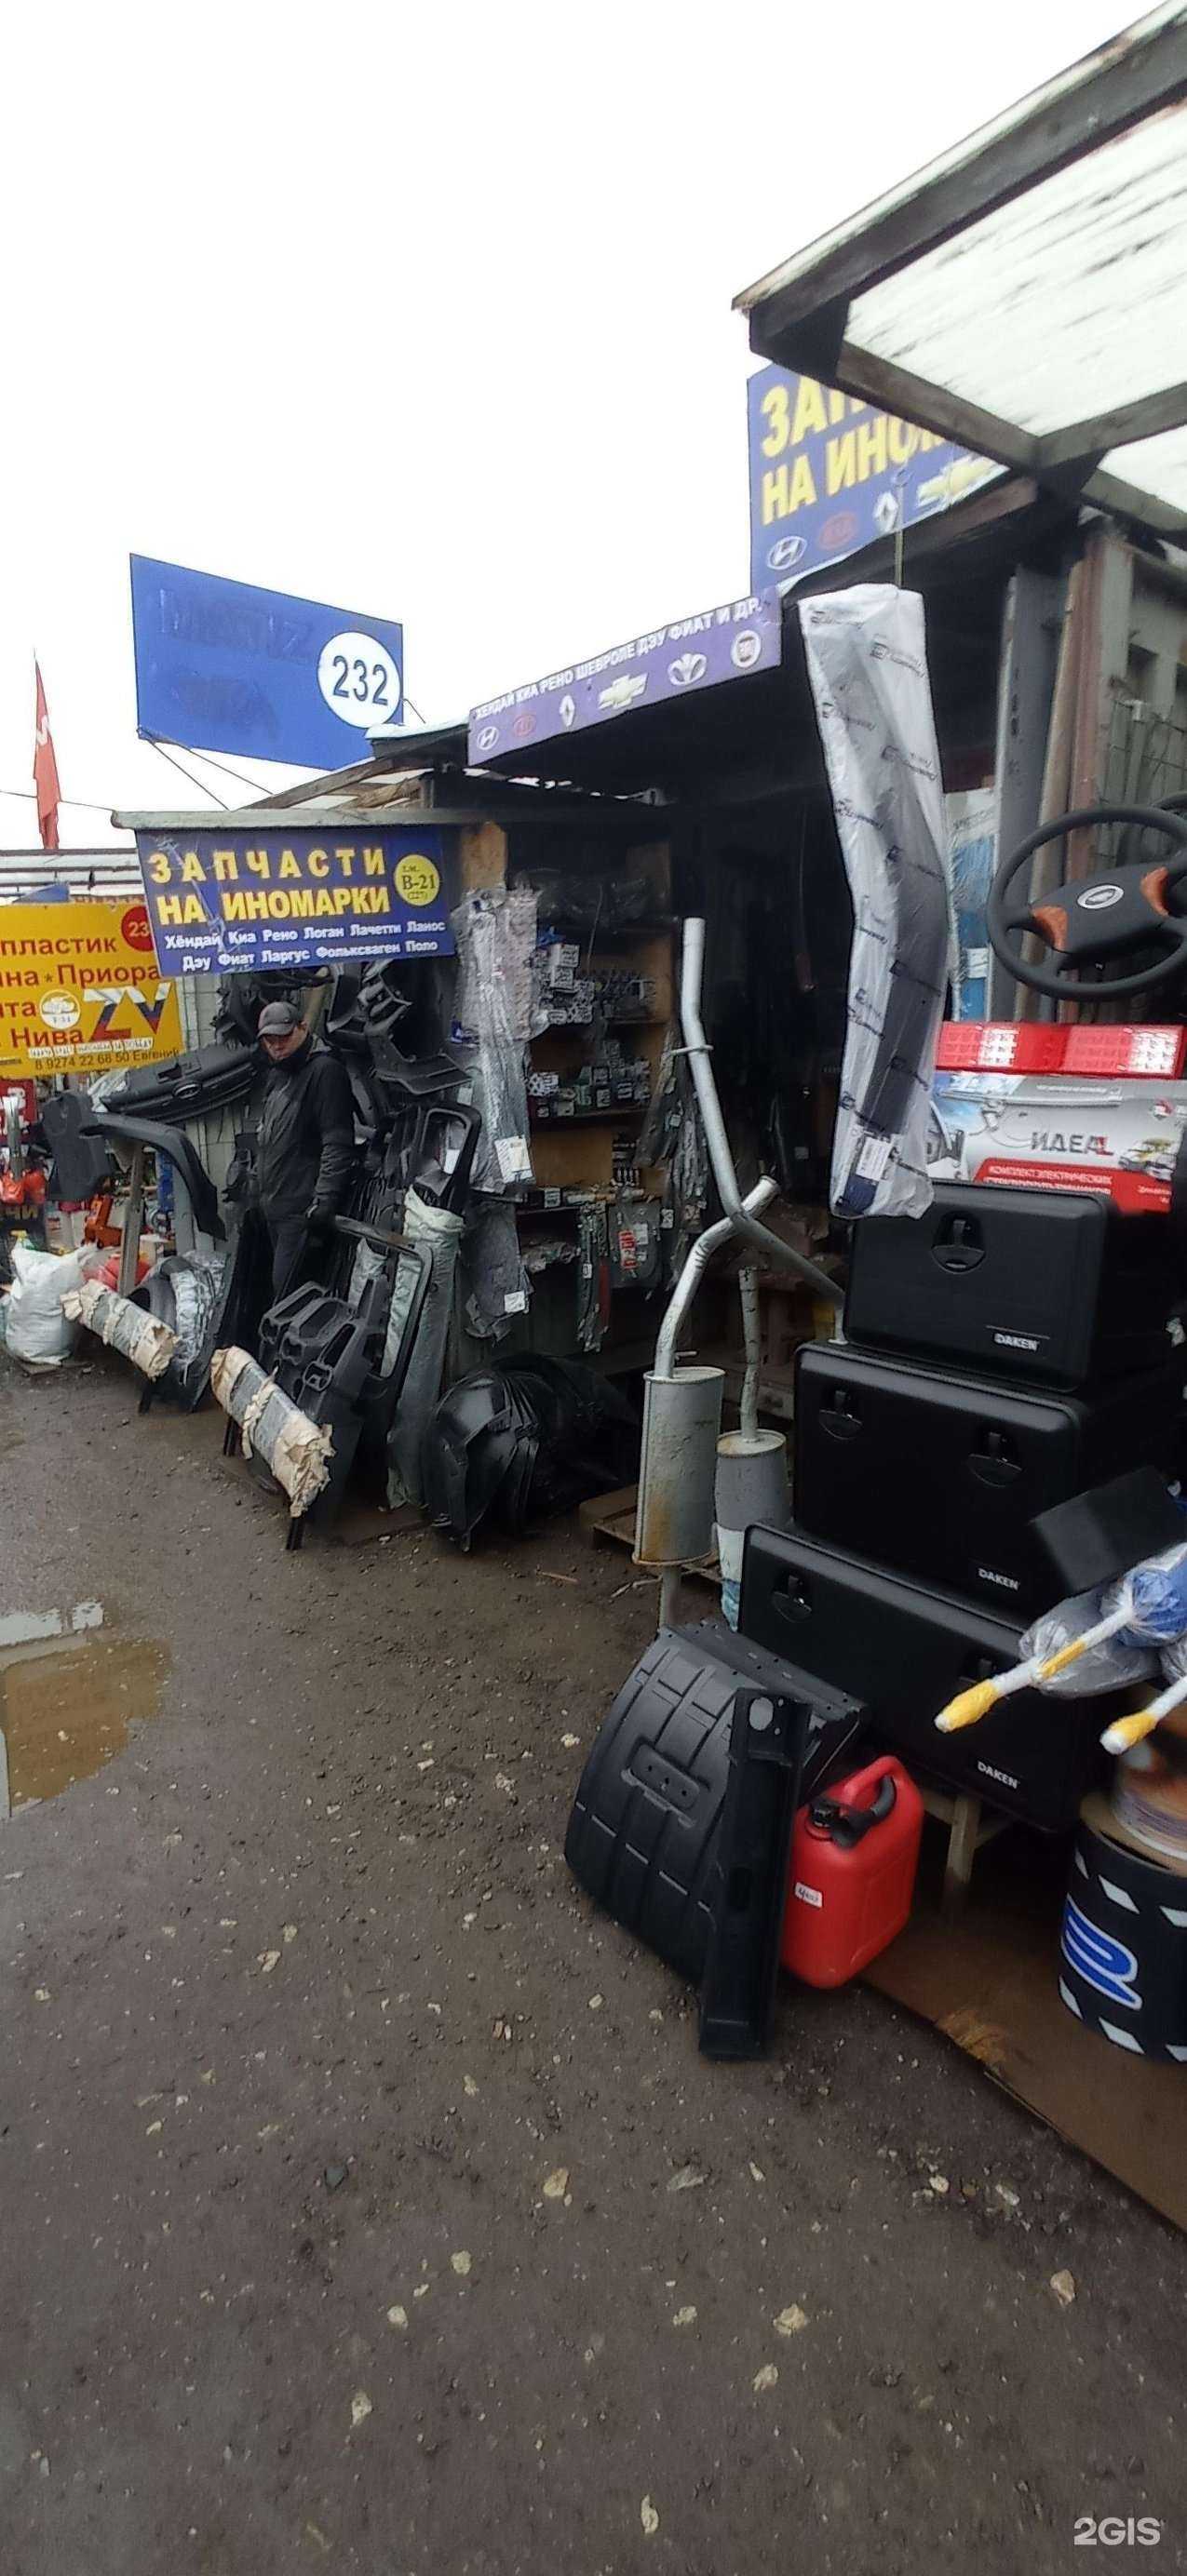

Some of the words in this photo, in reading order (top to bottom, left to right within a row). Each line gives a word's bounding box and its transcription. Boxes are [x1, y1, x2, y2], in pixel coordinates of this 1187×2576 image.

[762, 454, 817, 527] НА
[539, 669, 573, 696] РЕНО
[573, 644, 637, 681] ШЕВРОЛЕ
[637, 632, 667, 657] ДЭУ
[668, 613, 714, 640] ФИАТ
[715, 606, 731, 625] И
[332, 654, 389, 706] 232
[149, 848, 386, 884] ЗАПЧАСТИ
[156, 893, 207, 925] НА
[222, 886, 391, 921] ИНОМАРКИ
[165, 932, 222, 951] Хёндай
[228, 931, 256, 946] Киа
[263, 929, 298, 942] Рено
[303, 925, 344, 941] Логан
[350, 921, 402, 936] Лачетти
[407, 919, 446, 933] Ланос
[182, 954, 212, 973] Дэу
[218, 950, 255, 967] Фиат
[262, 947, 310, 964] Ларгус
[316, 941, 400, 959] Фольксваген
[405, 938, 438, 952] Поло
[57, 963, 161, 989] Приора
[10, 1026, 84, 1050] Нива
[34, 1059, 44, 1071] 8
[47, 1056, 76, 1070] 9274
[80, 1053, 95, 1067] 22
[98, 1052, 113, 1064] 68
[116, 1051, 130, 1063] 50
[133, 1047, 181, 1061] Евгений
[994, 1333, 1038, 1350] DAKEN
[978, 1567, 1019, 1591] DAKEN
[978, 1761, 1018, 1789] DAKEN
